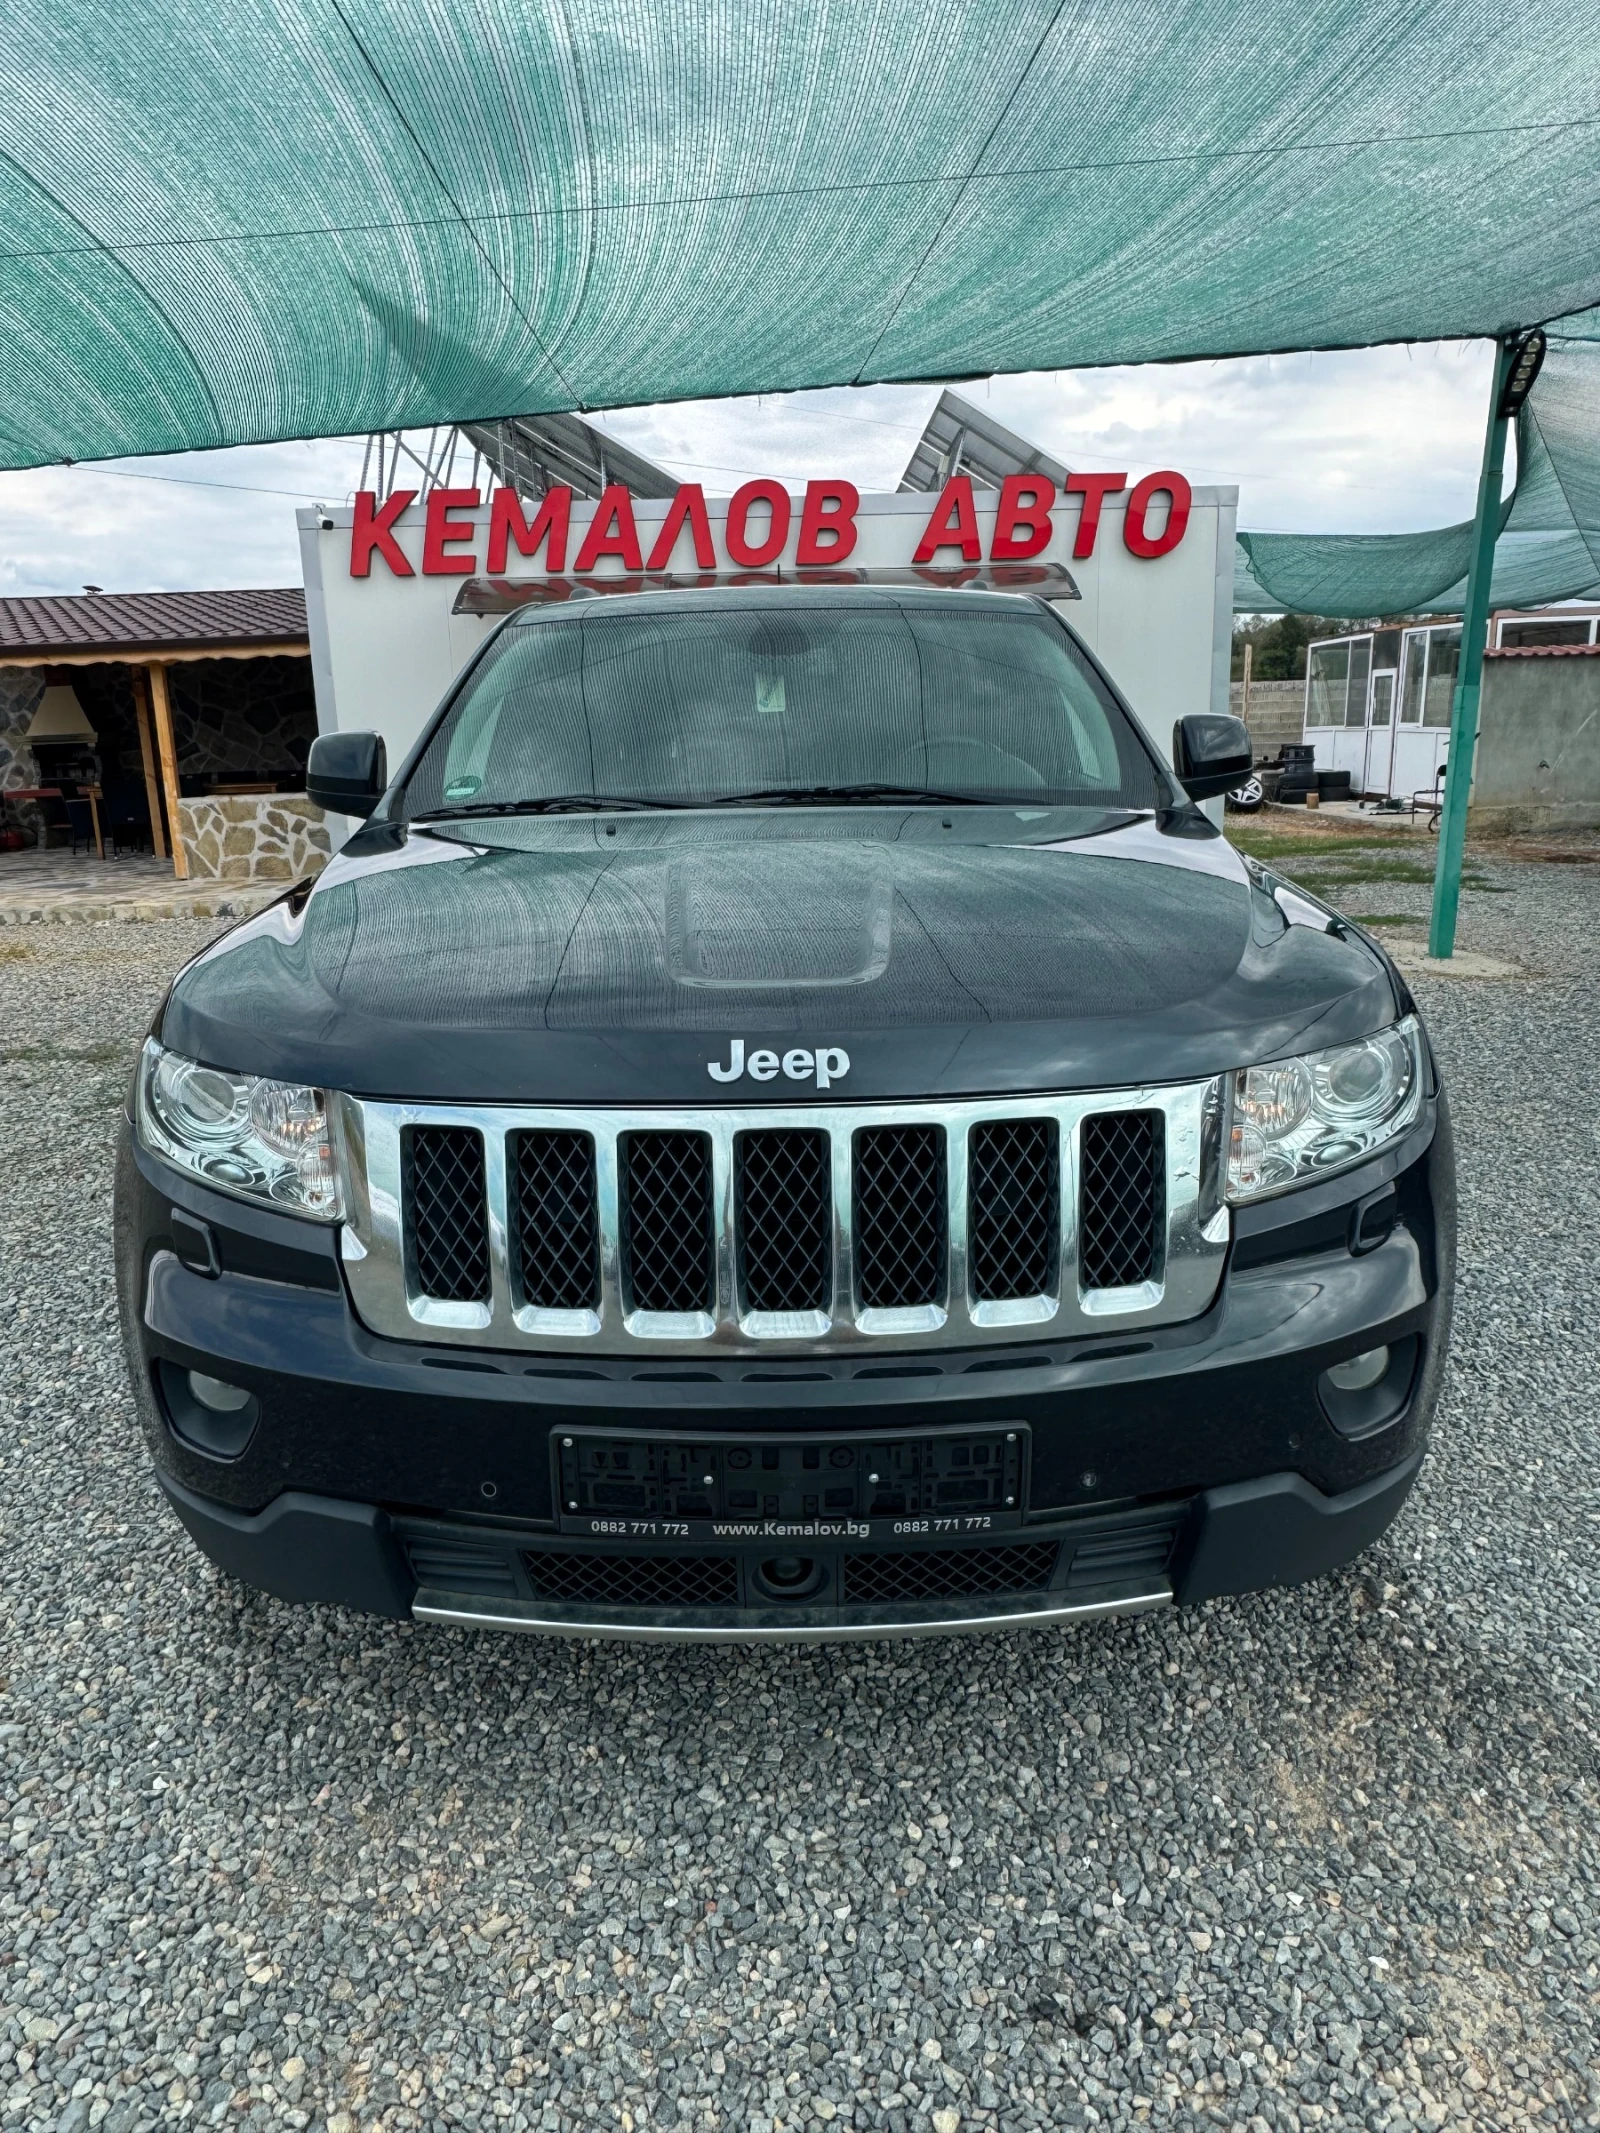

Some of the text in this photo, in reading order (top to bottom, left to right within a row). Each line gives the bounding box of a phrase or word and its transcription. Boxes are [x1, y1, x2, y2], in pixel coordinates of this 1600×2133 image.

[350, 470, 1192, 577] КЕМАЛОВ АВТО
[707, 1039, 851, 1090] Jeep
[590, 1520, 689, 1535] 0882 771 772
[712, 1520, 870, 1538] www.Kemalov.bg
[893, 1516, 991, 1533] 0882 771 772
